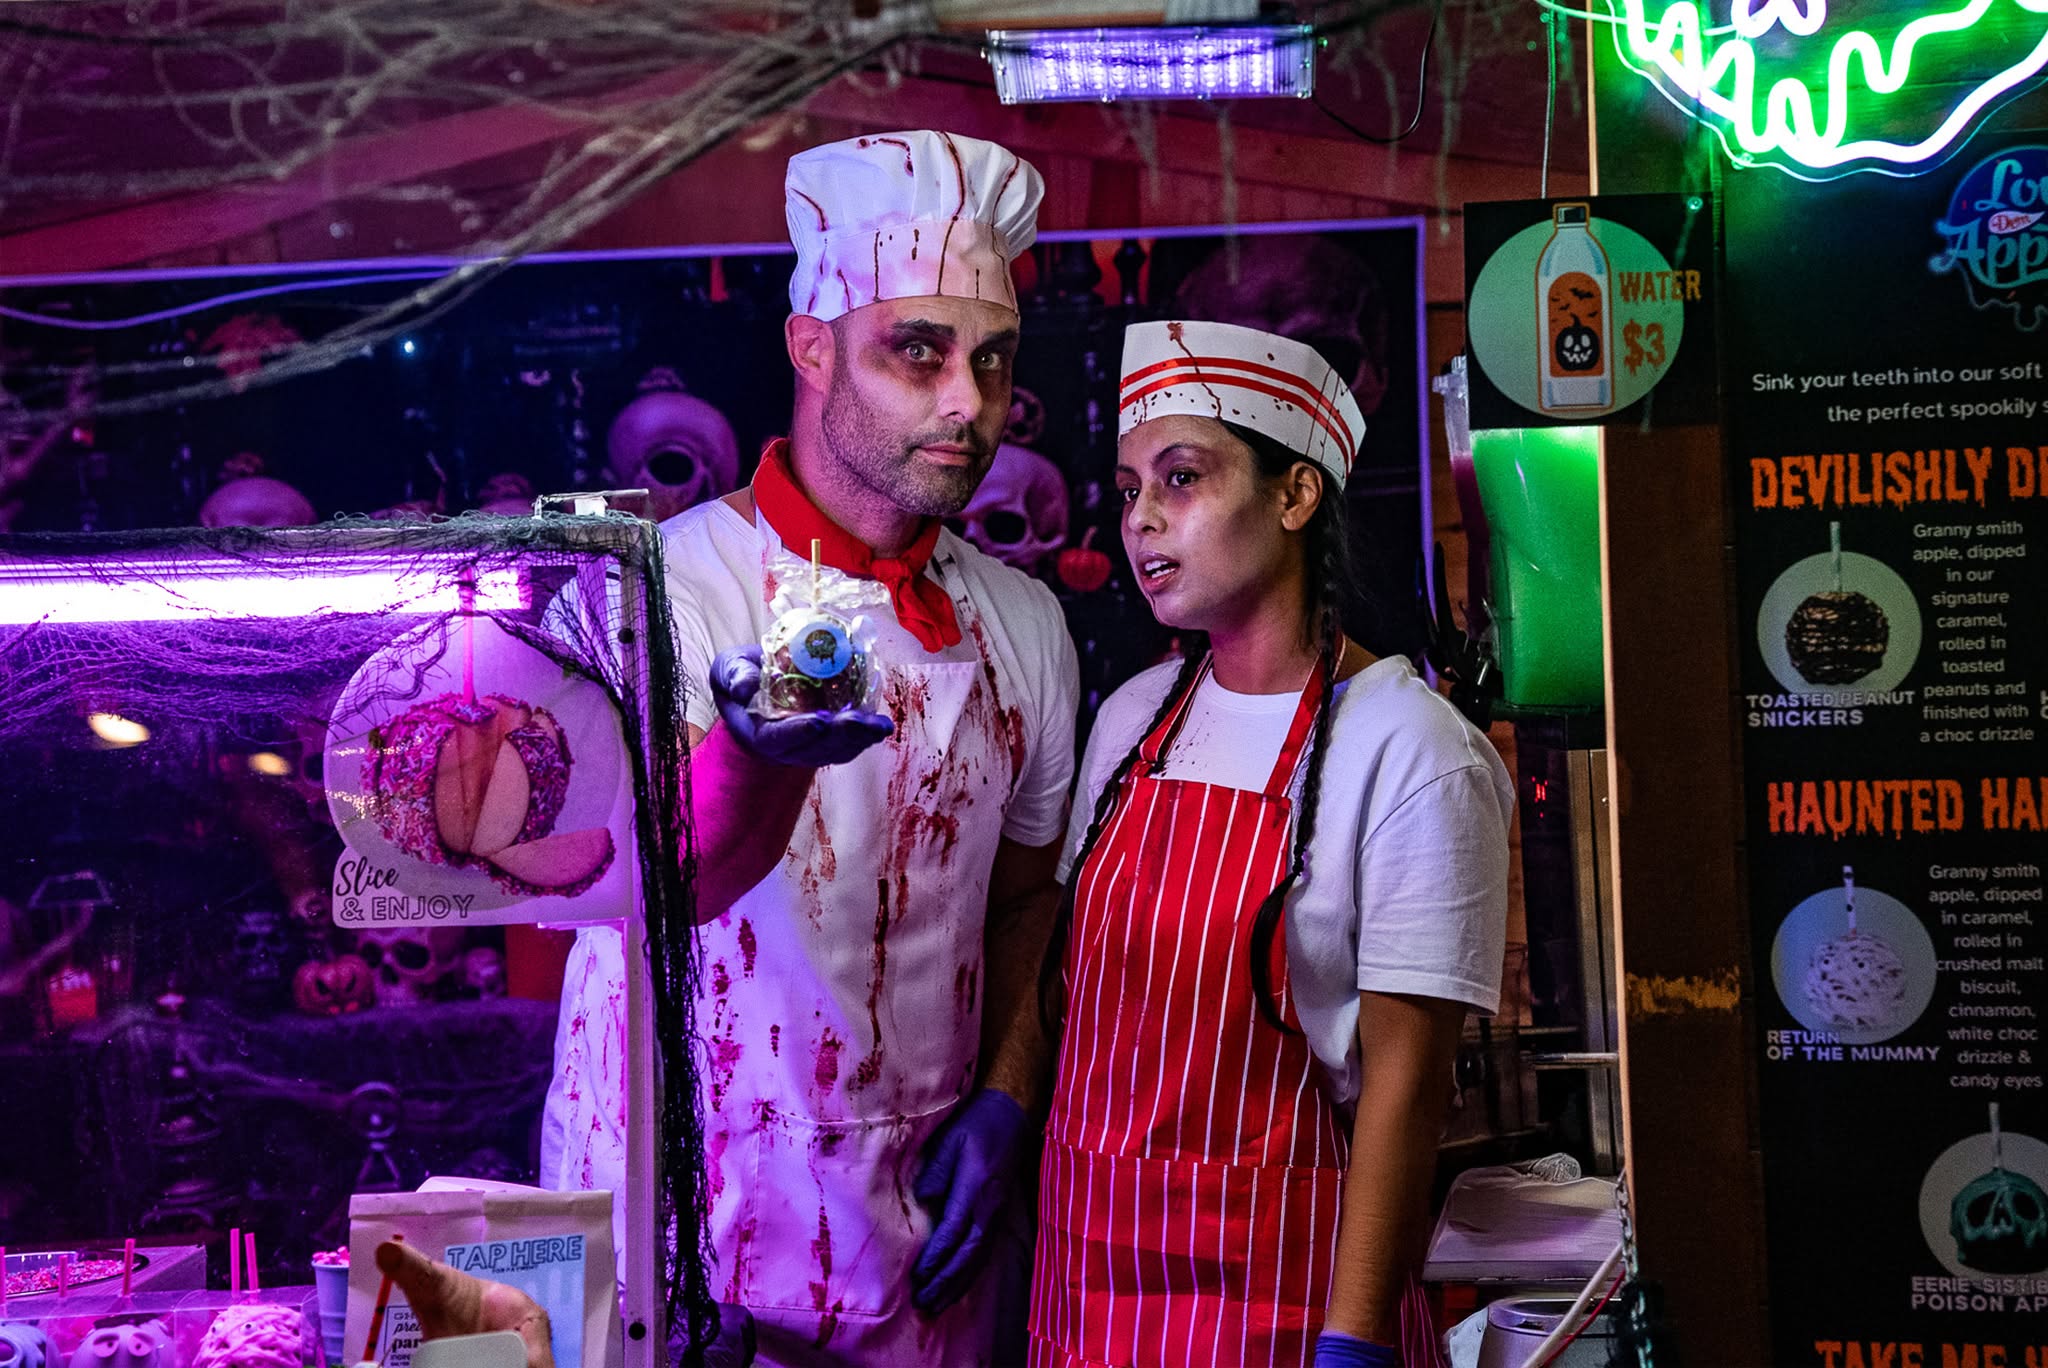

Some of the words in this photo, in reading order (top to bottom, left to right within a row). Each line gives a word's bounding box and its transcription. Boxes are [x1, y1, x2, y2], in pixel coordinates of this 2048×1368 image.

[1620, 270, 1701, 303] WATER
[1623, 319, 1665, 376] $3
[1752, 373, 1795, 392] Sink
[1800, 374, 1846, 393] your
[1852, 369, 1908, 387] teeth
[1914, 367, 1954, 384] into
[1959, 369, 1993, 382] our
[2000, 362, 2042, 380] soft
[1828, 406, 1862, 422] the
[1867, 402, 1944, 423] perfect
[1950, 398, 2036, 420] spookily
[1751, 447, 1992, 512] DEVILISHLY
[1913, 524, 1972, 539] Granny
[1976, 521, 2023, 536] smith
[1912, 548, 1963, 562] apple,
[1967, 544, 2026, 559] dipped
[1946, 568, 1962, 582] in
[1966, 569, 1994, 581] our
[1932, 591, 2010, 608] signature
[1936, 614, 2007, 628] caramel,
[1939, 636, 1985, 650] rolled
[1990, 635, 2006, 649] in
[1942, 659, 2004, 674] toasted
[1924, 684, 1990, 700] peanuts
[1994, 682, 2026, 696] and
[1746, 693, 1835, 708] TOASTED
[1840, 691, 1915, 706] PEANUT
[1748, 710, 1864, 727] SNICKERS
[1923, 706, 1989, 720] finished
[1994, 704, 2028, 718] with
[1920, 731, 1930, 742] a
[1935, 728, 1974, 742] choc
[1979, 727, 2034, 740] drizzle
[1768, 779, 1964, 842] HAUNTED
[335, 856, 399, 897] Slice
[1929, 865, 1988, 880] Granny
[1992, 862, 2040, 878] smith
[1929, 889, 1979, 903] apple,
[1984, 887, 2042, 902] dipped
[340, 897, 364, 921] &
[372, 894, 474, 920] ENJOY
[1942, 910, 1957, 924] in
[1962, 910, 2032, 925] caramel,
[1954, 934, 2000, 948] rolled
[2007, 933, 2022, 947] in
[1936, 957, 2002, 971] crushed
[2006, 957, 2043, 970] malt
[1960, 980, 2021, 995] biscuit,
[1949, 1003, 2036, 1018] cinnamon,
[1768, 1030, 1839, 1044] RETURN
[1947, 1027, 1993, 1041] white
[1998, 1026, 2038, 1040] choc
[1767, 1046, 1794, 1061] OF
[1802, 1047, 1843, 1061] THE
[1851, 1046, 1940, 1061] MUMMY
[1957, 1050, 2013, 1064] drizzle
[2018, 1050, 2031, 1063] &
[1950, 1073, 1999, 1089] candy
[2004, 1074, 2043, 1088] eyes
[448, 1244, 507, 1271] TAP
[511, 1235, 584, 1266] HERE
[1912, 1295, 2004, 1312] POISON
